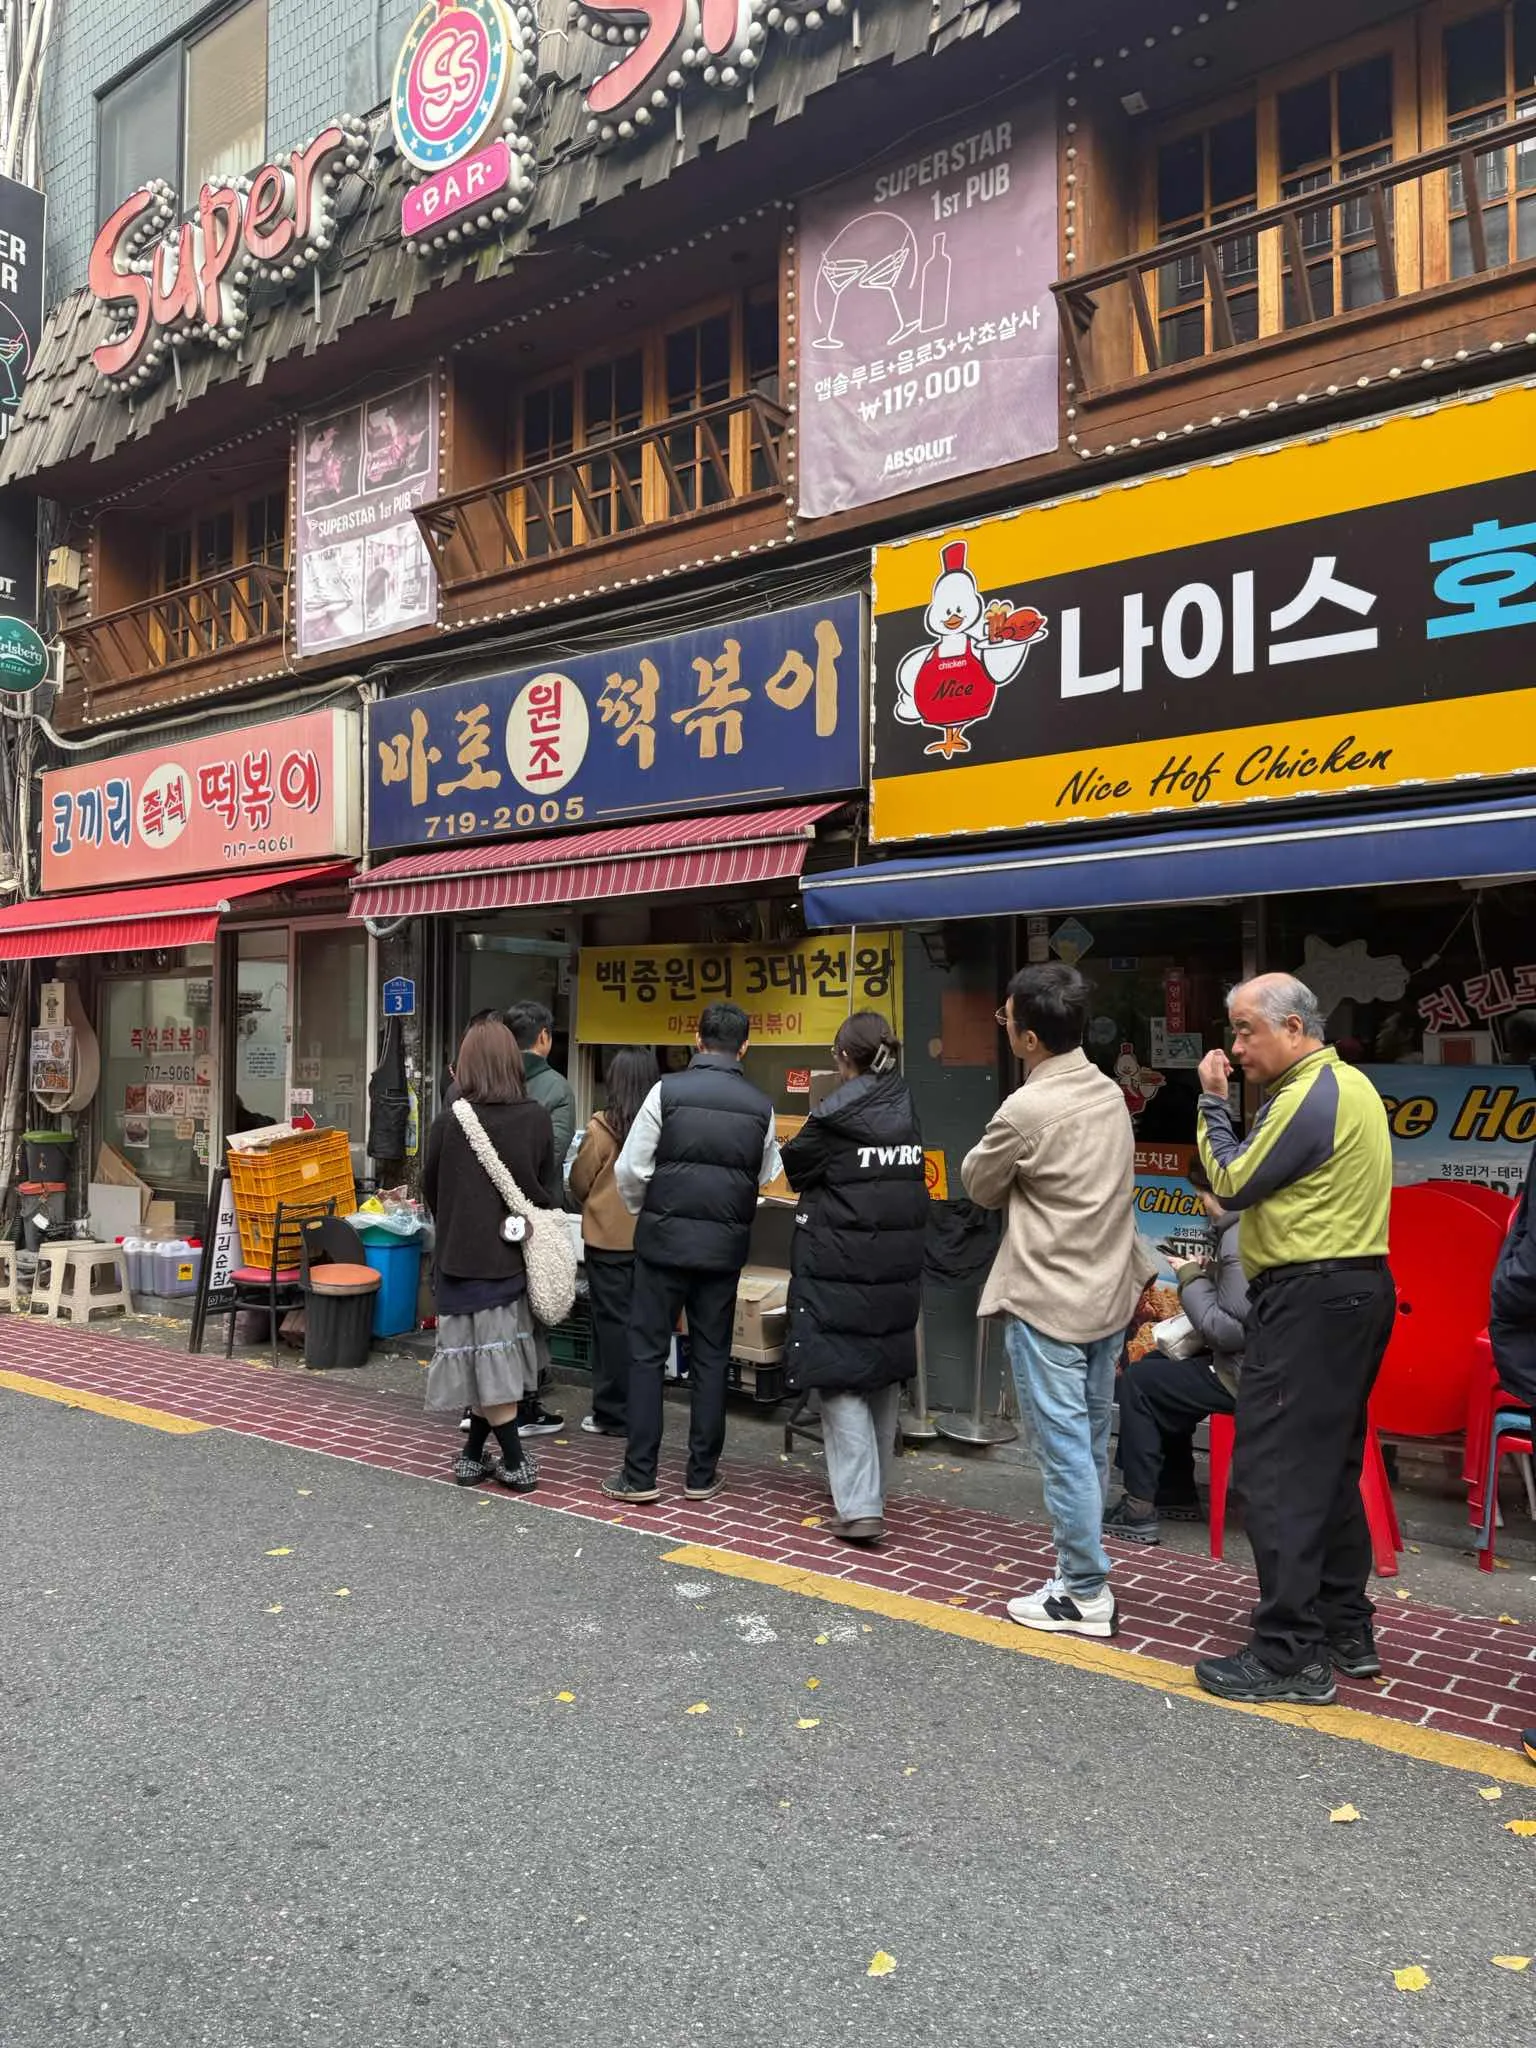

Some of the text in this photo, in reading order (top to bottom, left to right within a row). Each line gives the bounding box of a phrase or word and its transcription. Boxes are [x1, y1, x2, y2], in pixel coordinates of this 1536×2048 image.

[873, 121, 1012, 204] SUPERSTAR
[422, 161, 485, 217] BAR
[966, 162, 1011, 209] PUB
[88, 126, 346, 377] Super
[858, 359, 982, 423] ₩119,000
[882, 436, 955, 474] ABSOLUT
[317, 506, 376, 538] SUPERSTAR
[393, 493, 413, 515] PUB
[1059, 518, 1536, 700] 나이스 호
[938, 659, 968, 671] chicken
[378, 618, 843, 807] 마포 원조 떡볶이
[931, 679, 975, 702] Nice
[1055, 734, 1391, 808] Nice Hof Chicken
[51, 749, 321, 857] 코끼리 즉석 떡볶이
[424, 796, 585, 839] 719-2005
[223, 835, 295, 860] 717-9061
[595, 947, 896, 1003] 백종원의 3대천왕
[395, 995, 403, 1011] 3
[668, 1012, 803, 1036] 마포 떡볶이
[144, 1065, 196, 1082] 717-9061
[857, 1145, 922, 1168] TWRC
[1133, 1150, 1179, 1171] 프치킨
[1138, 1185, 1208, 1217] Chick
